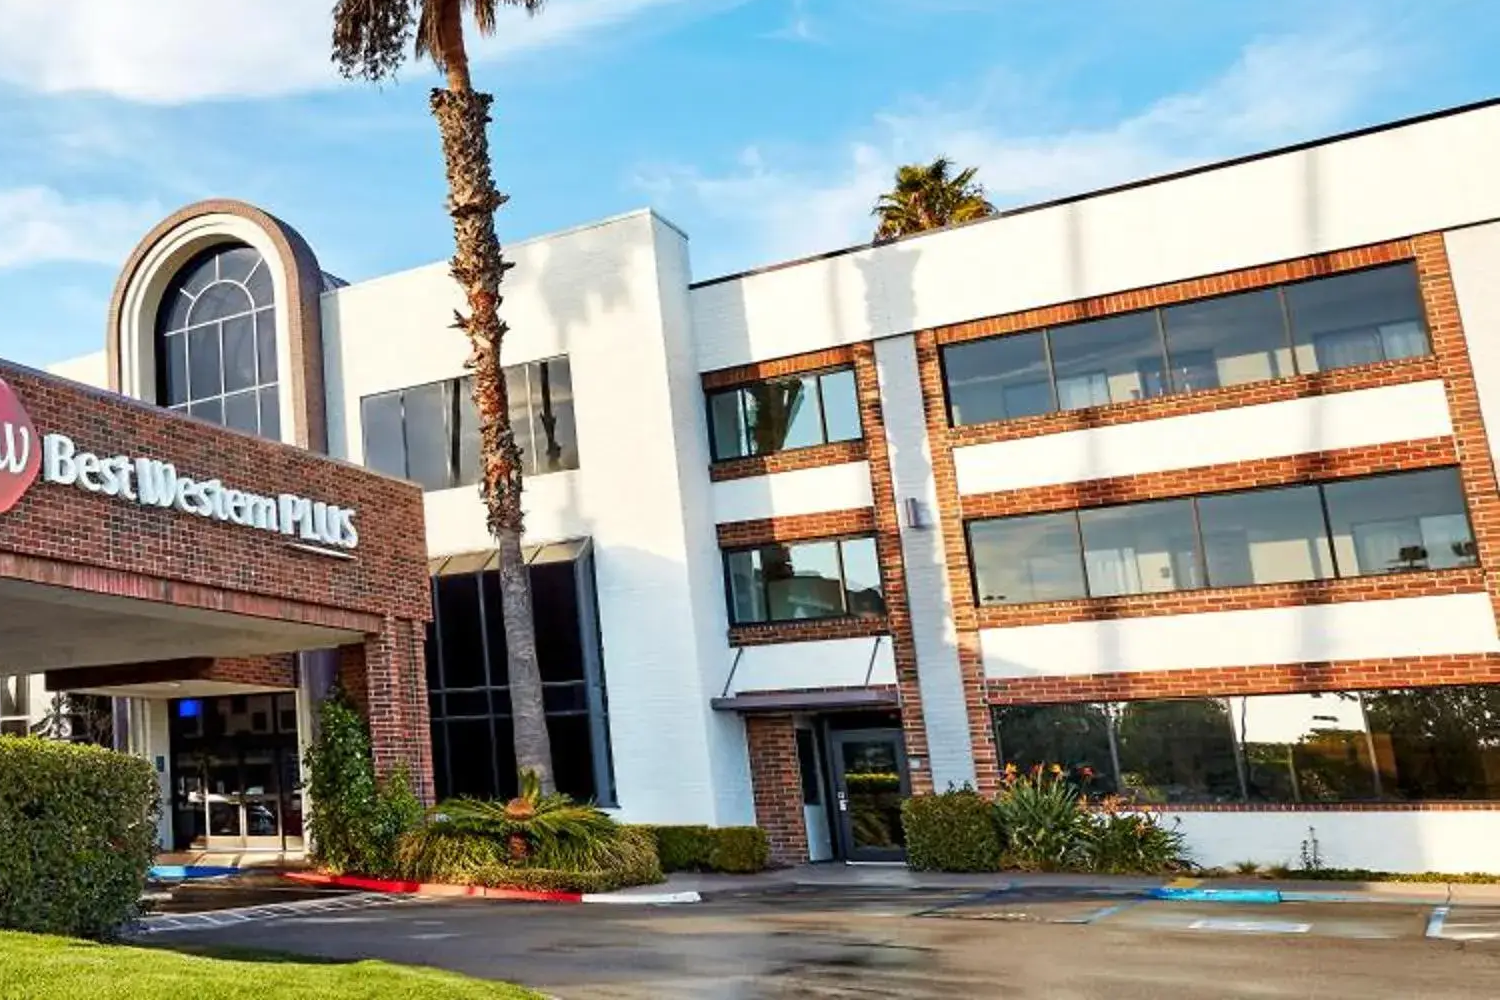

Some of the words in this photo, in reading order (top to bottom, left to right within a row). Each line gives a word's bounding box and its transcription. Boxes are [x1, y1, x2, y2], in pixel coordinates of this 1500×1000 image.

[43, 433, 137, 500] Best
[135, 457, 279, 532] Western
[278, 493, 359, 549] PLUS
